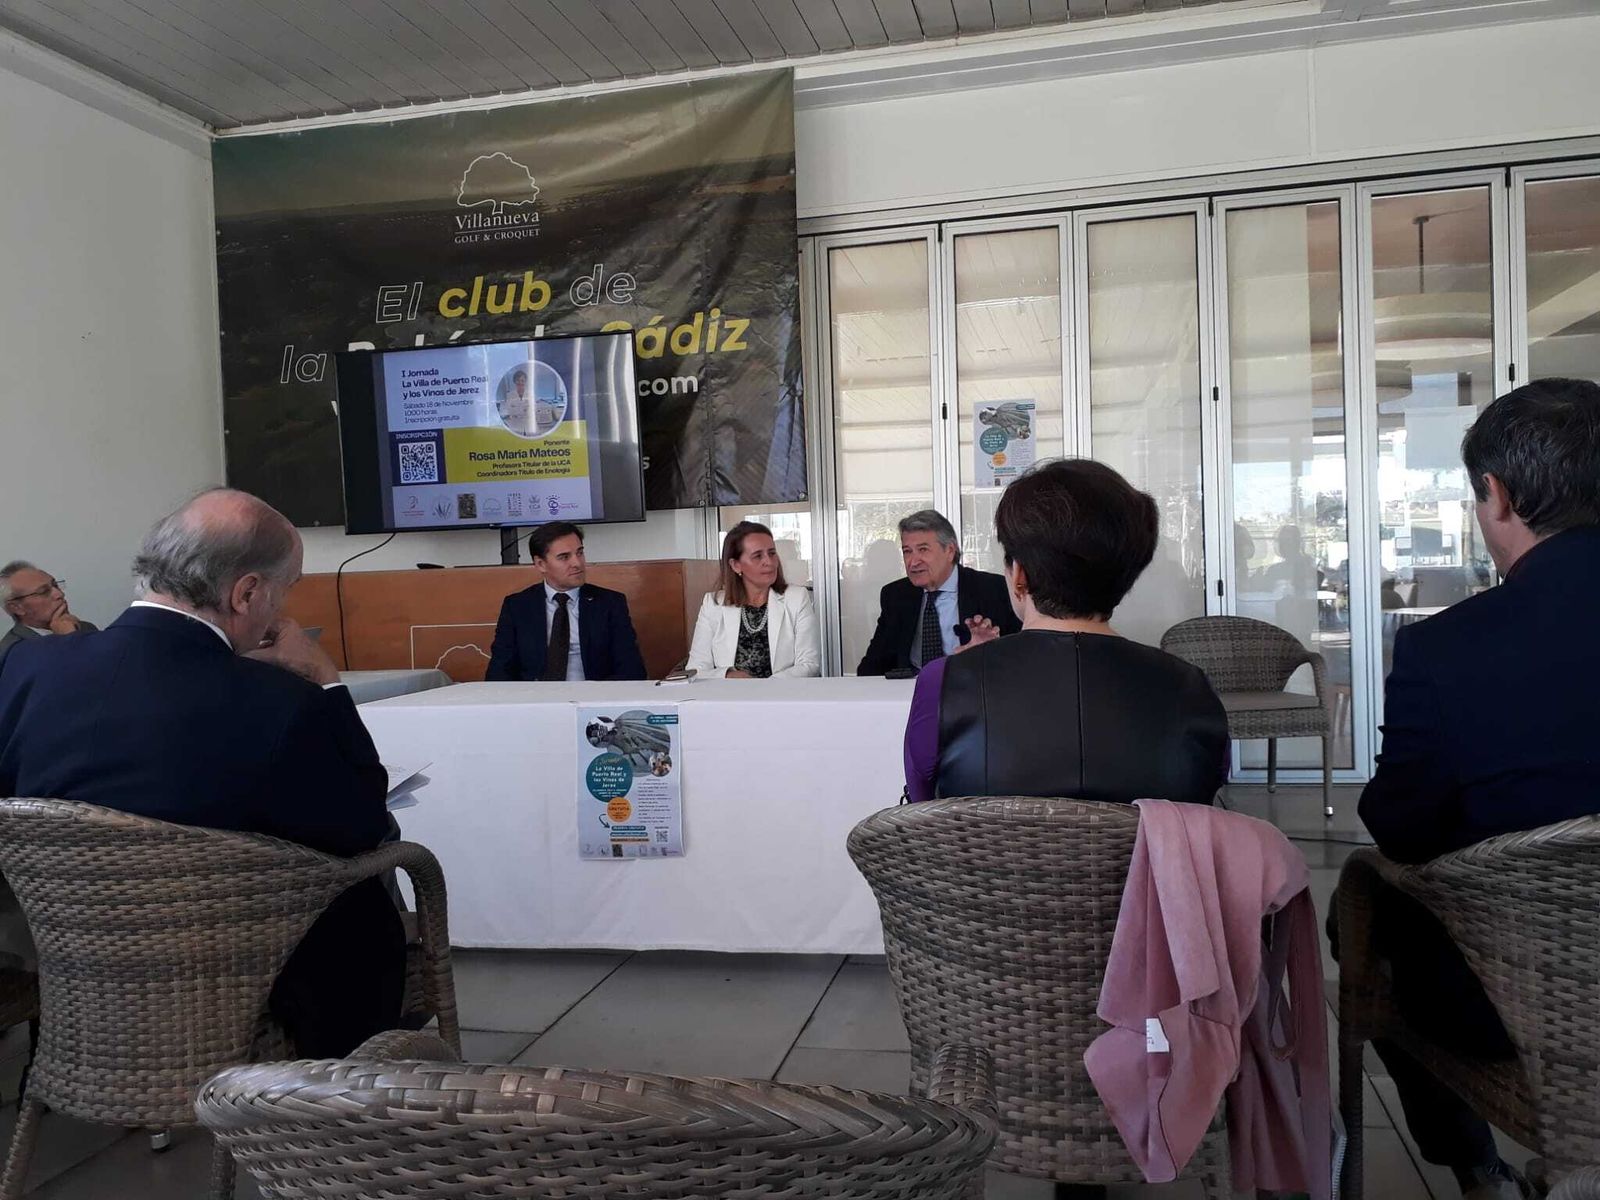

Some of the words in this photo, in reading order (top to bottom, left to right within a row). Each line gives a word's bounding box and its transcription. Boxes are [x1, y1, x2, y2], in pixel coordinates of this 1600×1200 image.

[455, 212, 539, 229] Villanueva
[454, 234, 480, 244] GOLF
[494, 228, 540, 240] CROQUET
[376, 282, 424, 324] El
[438, 270, 551, 318] club
[570, 264, 636, 306] de
[280, 344, 327, 384] la
[408, 368, 440, 377] Jornada
[469, 452, 495, 461] Rosa
[498, 449, 527, 459] María
[530, 448, 570, 458] Mateos
